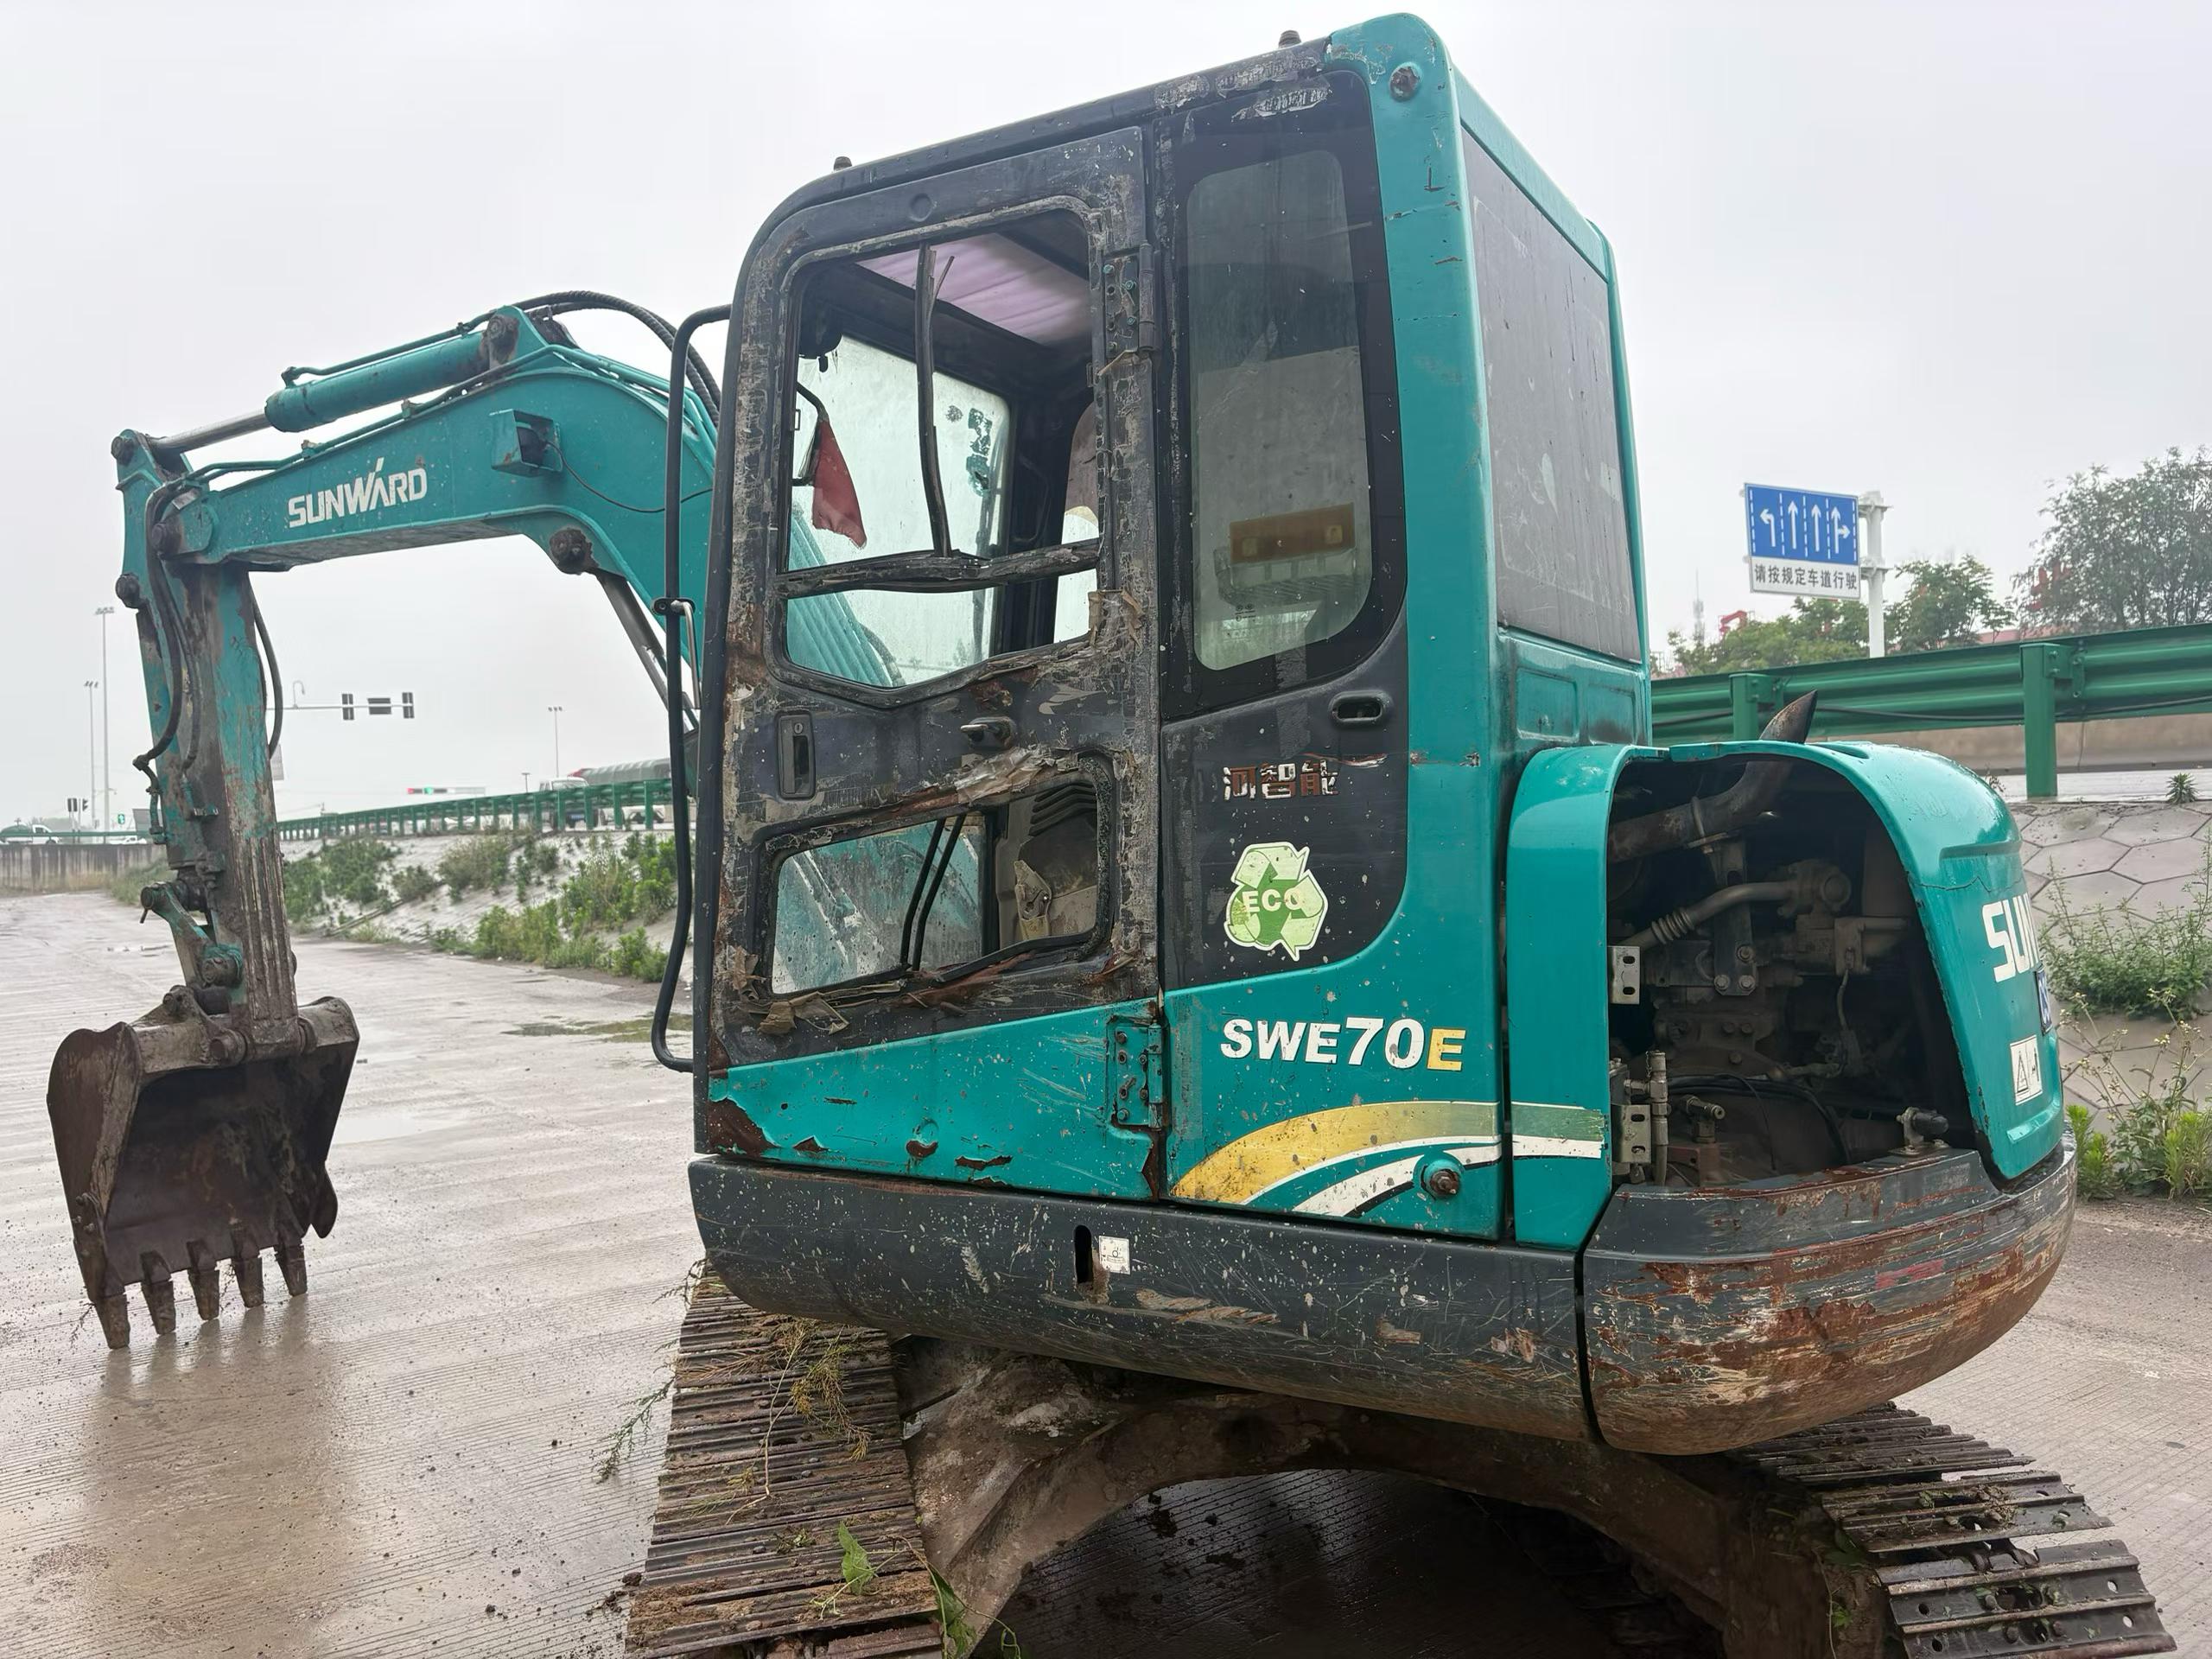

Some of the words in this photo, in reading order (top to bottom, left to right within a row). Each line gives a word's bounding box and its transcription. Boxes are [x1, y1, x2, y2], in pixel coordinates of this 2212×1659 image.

[288, 456, 428, 528] SUNWARD
[1754, 563, 1858, 590] 请按规定车道行驶
[1242, 888, 1300, 913] ECO
[1220, 1016, 1466, 1071] SWE70E
